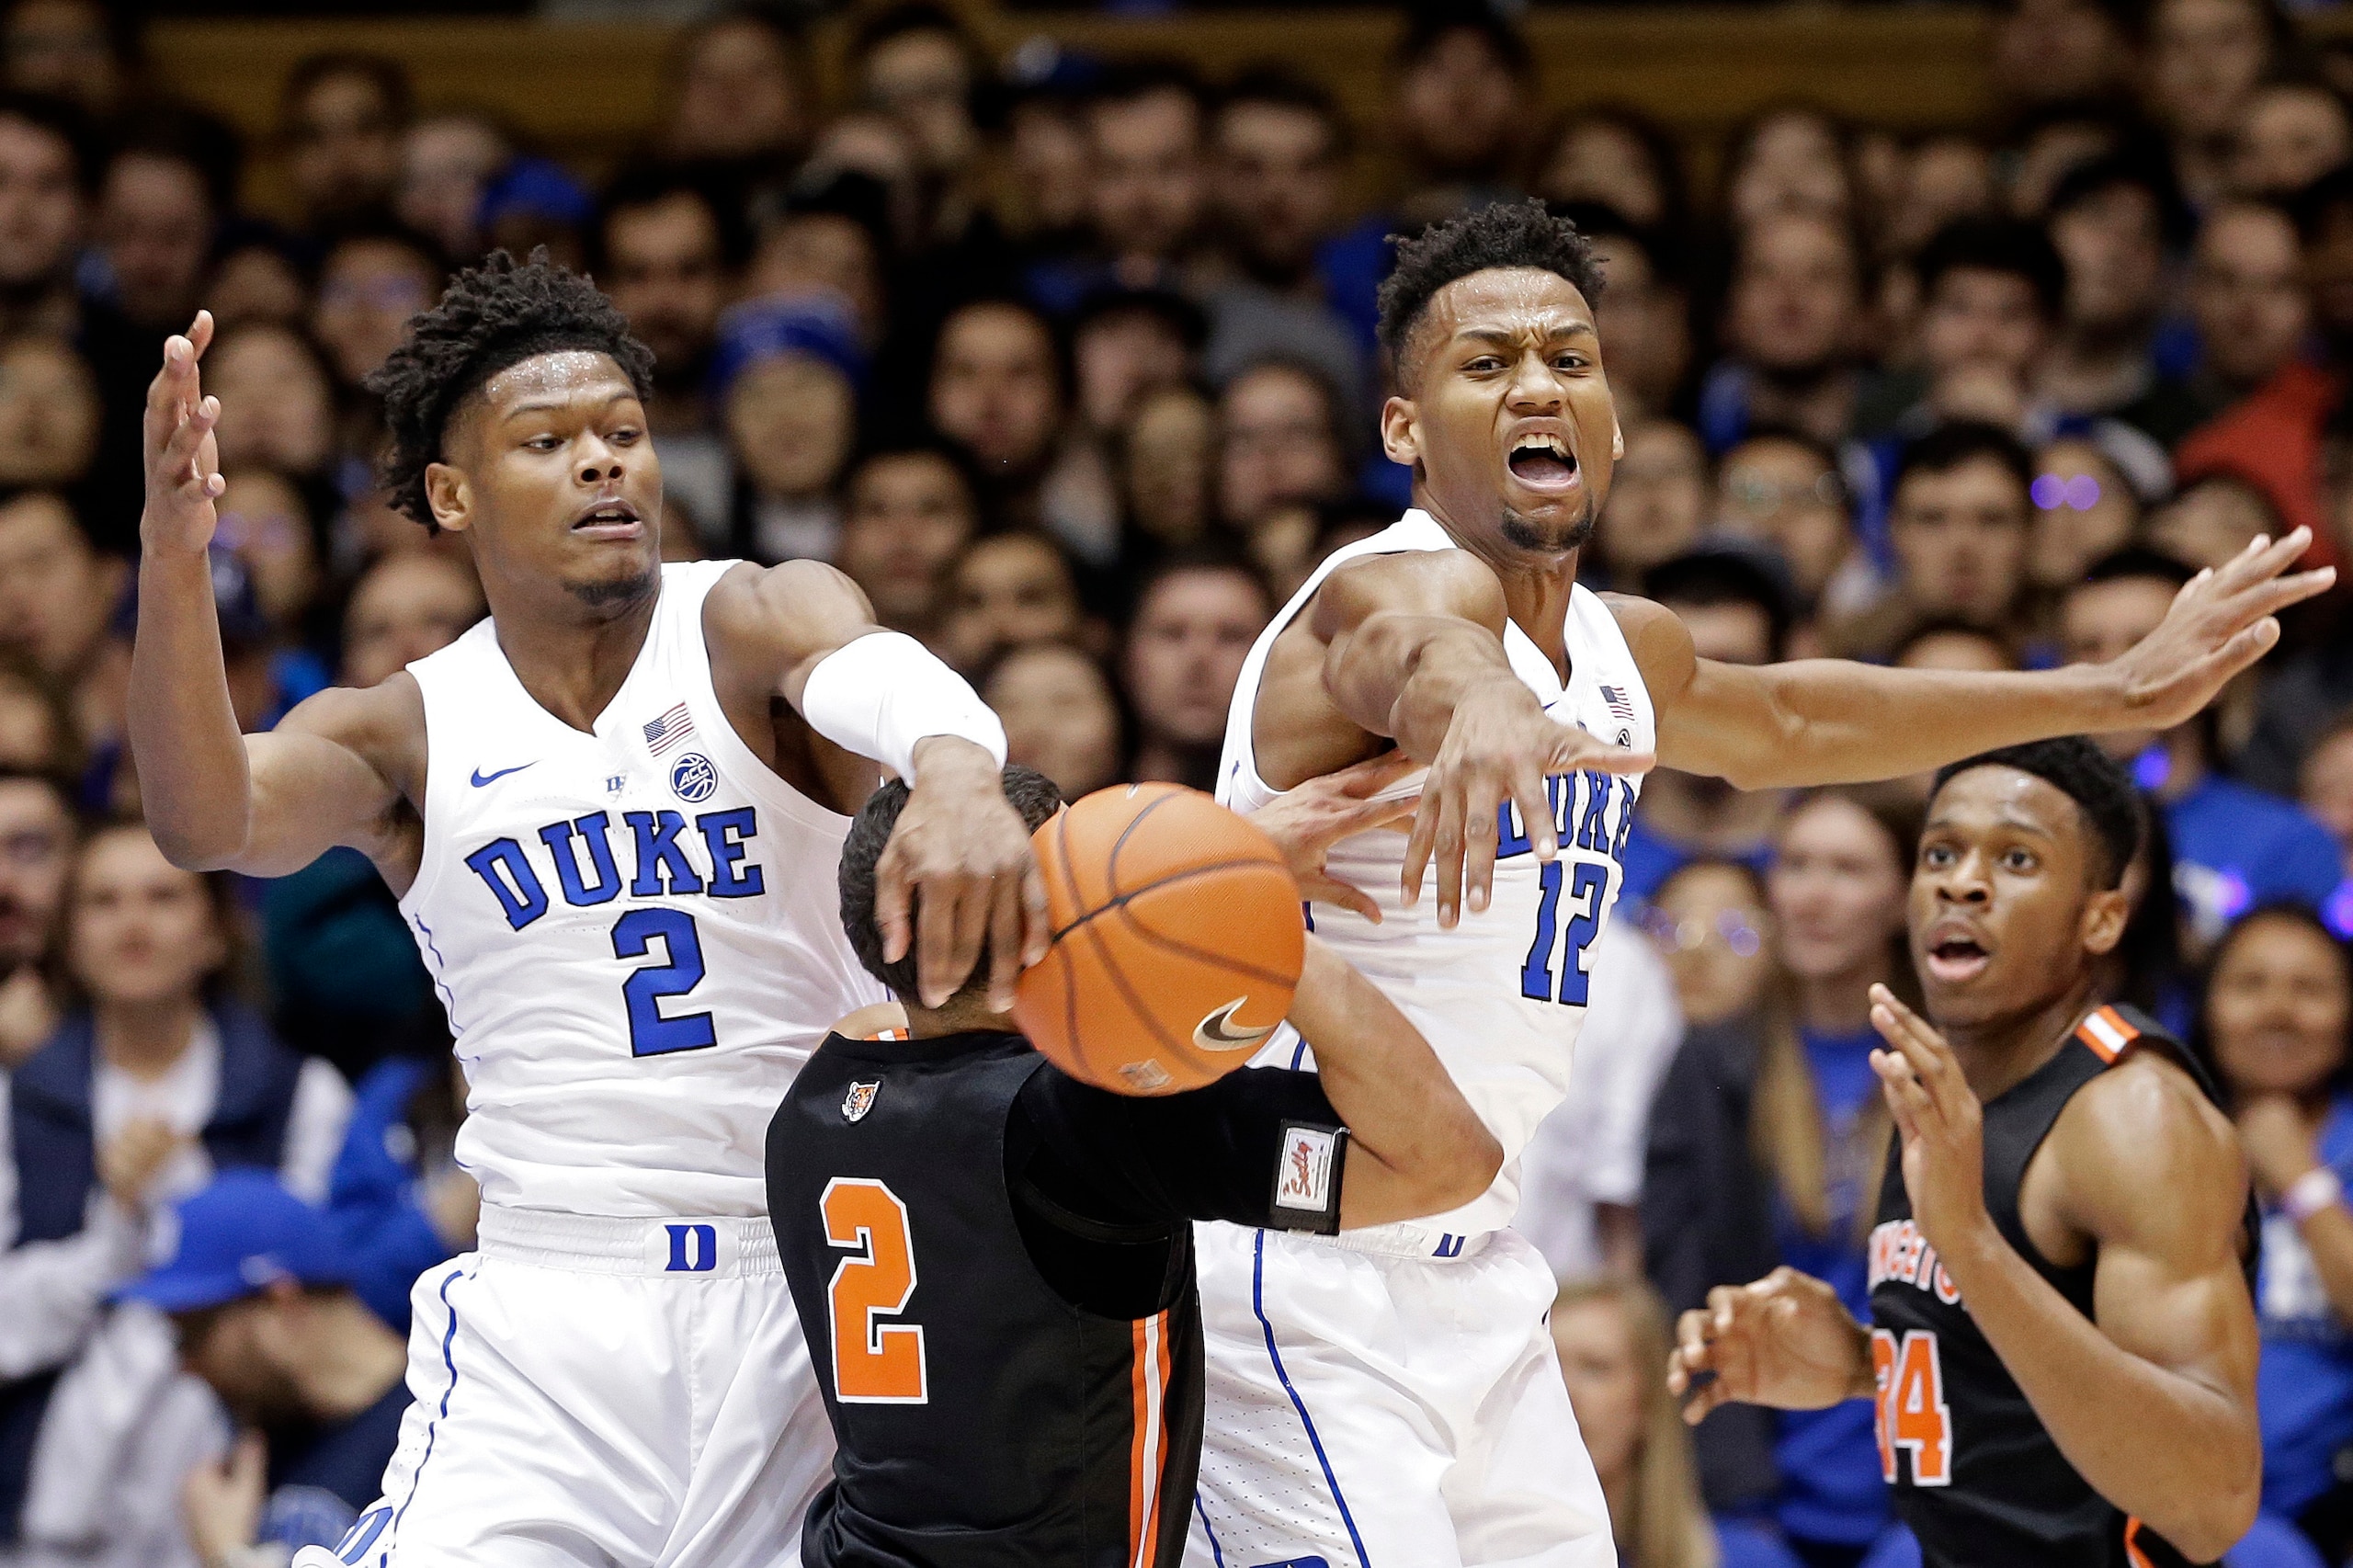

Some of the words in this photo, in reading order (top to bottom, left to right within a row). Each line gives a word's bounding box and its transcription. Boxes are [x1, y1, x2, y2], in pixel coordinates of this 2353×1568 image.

[678, 760, 710, 789] ACC
[464, 806, 766, 932] DUKE
[1520, 860, 1608, 1007] 12
[610, 907, 718, 1059] 2
[664, 1223, 717, 1272] D
[819, 1176, 928, 1404] 2
